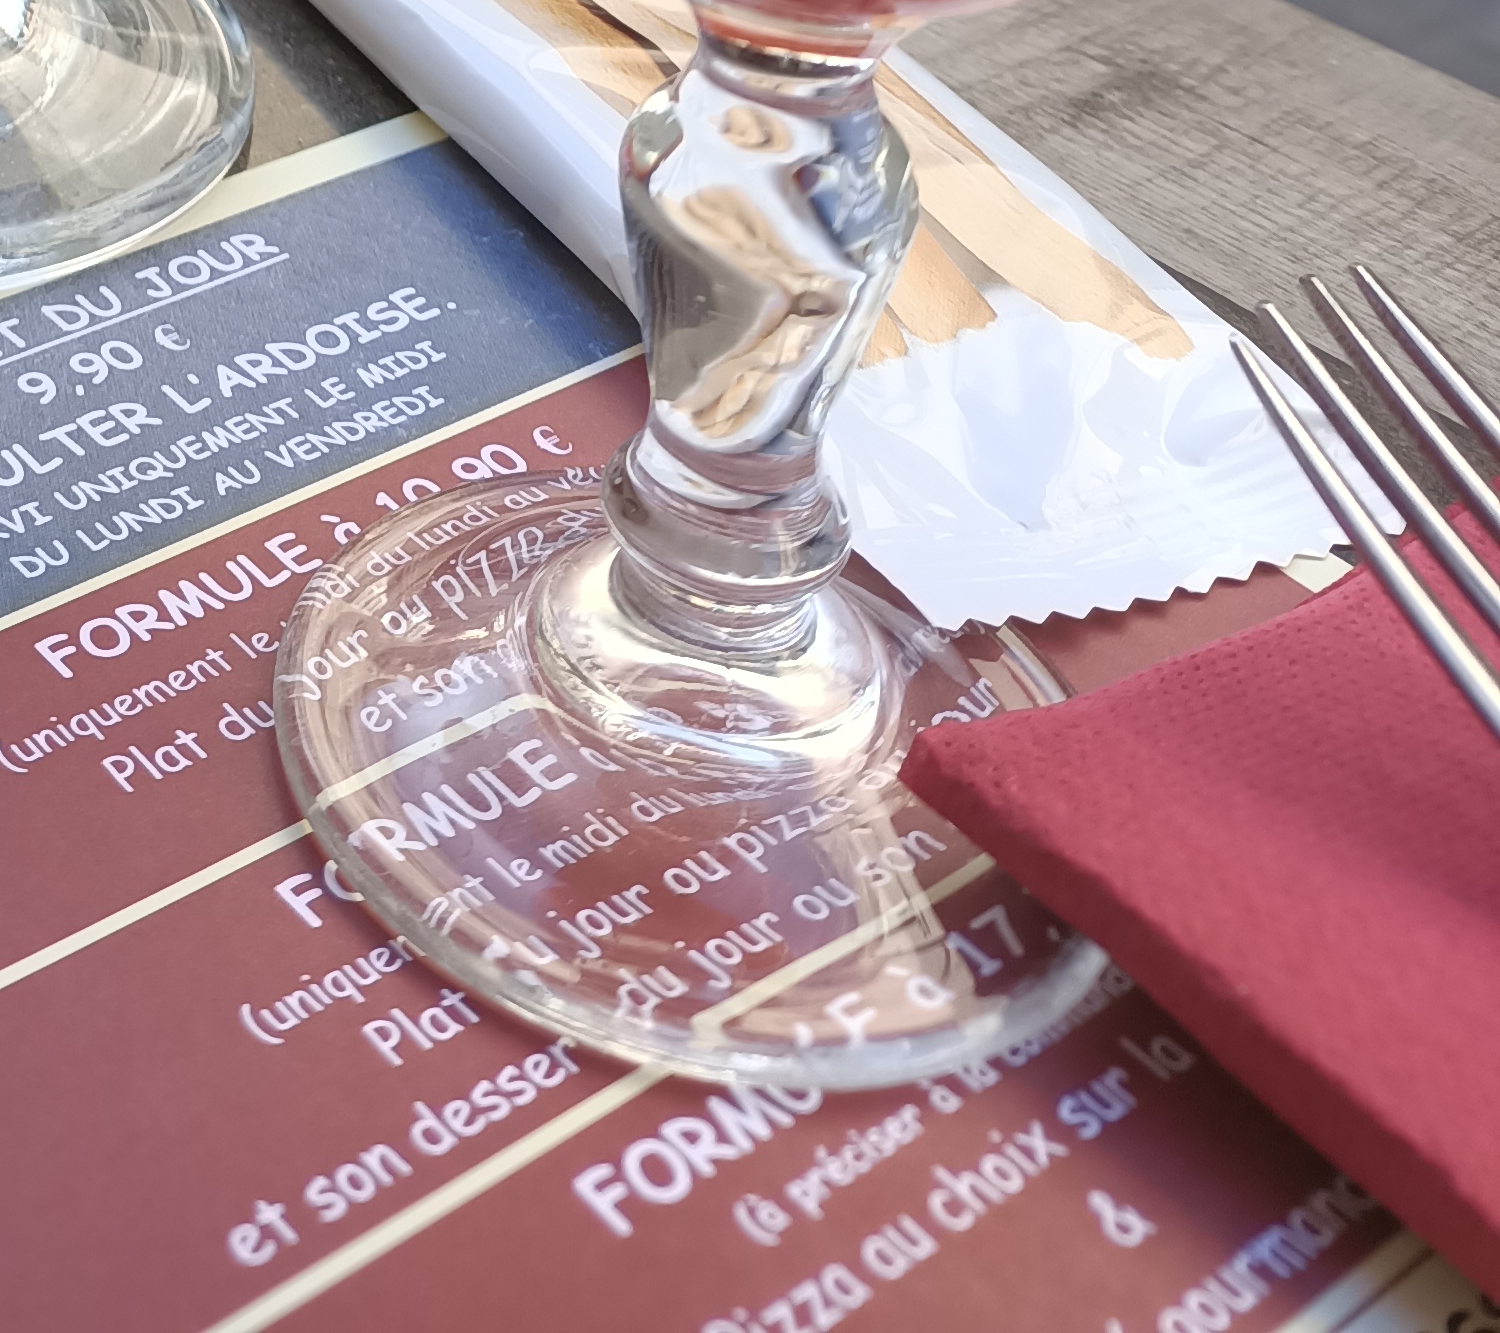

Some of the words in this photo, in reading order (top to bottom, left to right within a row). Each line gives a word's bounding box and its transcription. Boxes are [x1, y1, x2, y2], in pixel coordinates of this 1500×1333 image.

[17, 339, 145, 406] 9,90
[154, 323, 191, 352] €
[40, 285, 124, 333] DU
[134, 232, 282, 299] JOUR
[160, 286, 460, 415] L'ARDOISE.
[8, 538, 71, 580] DU
[74, 484, 206, 552] LUNDI
[215, 458, 264, 497] AU
[264, 384, 447, 470] VENDREDI
[52, 395, 303, 513] UNIQUEMENT
[303, 375, 359, 410] LE
[359, 339, 449, 387] MIDI
[33, 530, 325, 680] FORMULE
[531, 424, 574, 455] €
[231, 627, 281, 661] le
[366, 542, 412, 577] du
[408, 501, 500, 551] lundi
[505, 487, 549, 511] au
[100, 728, 208, 794] Plat
[217, 693, 276, 744] du
[359, 687, 408, 733] et
[485, 856, 544, 888] le
[538, 807, 630, 870] midi
[629, 790, 686, 823] du
[362, 987, 481, 1067] Plat
[545, 882, 654, 960] jour
[662, 850, 732, 896] ou
[723, 793, 856, 874] pizza
[227, 1197, 301, 1269] et
[302, 1141, 414, 1225] son
[408, 1037, 583, 1156] desser
[673, 910, 782, 990] jour
[792, 875, 861, 922] ou
[855, 828, 948, 887] son
[859, 1212, 941, 1281] au
[925, 1118, 1070, 1233] choix
[1055, 1066, 1139, 1141] sur
